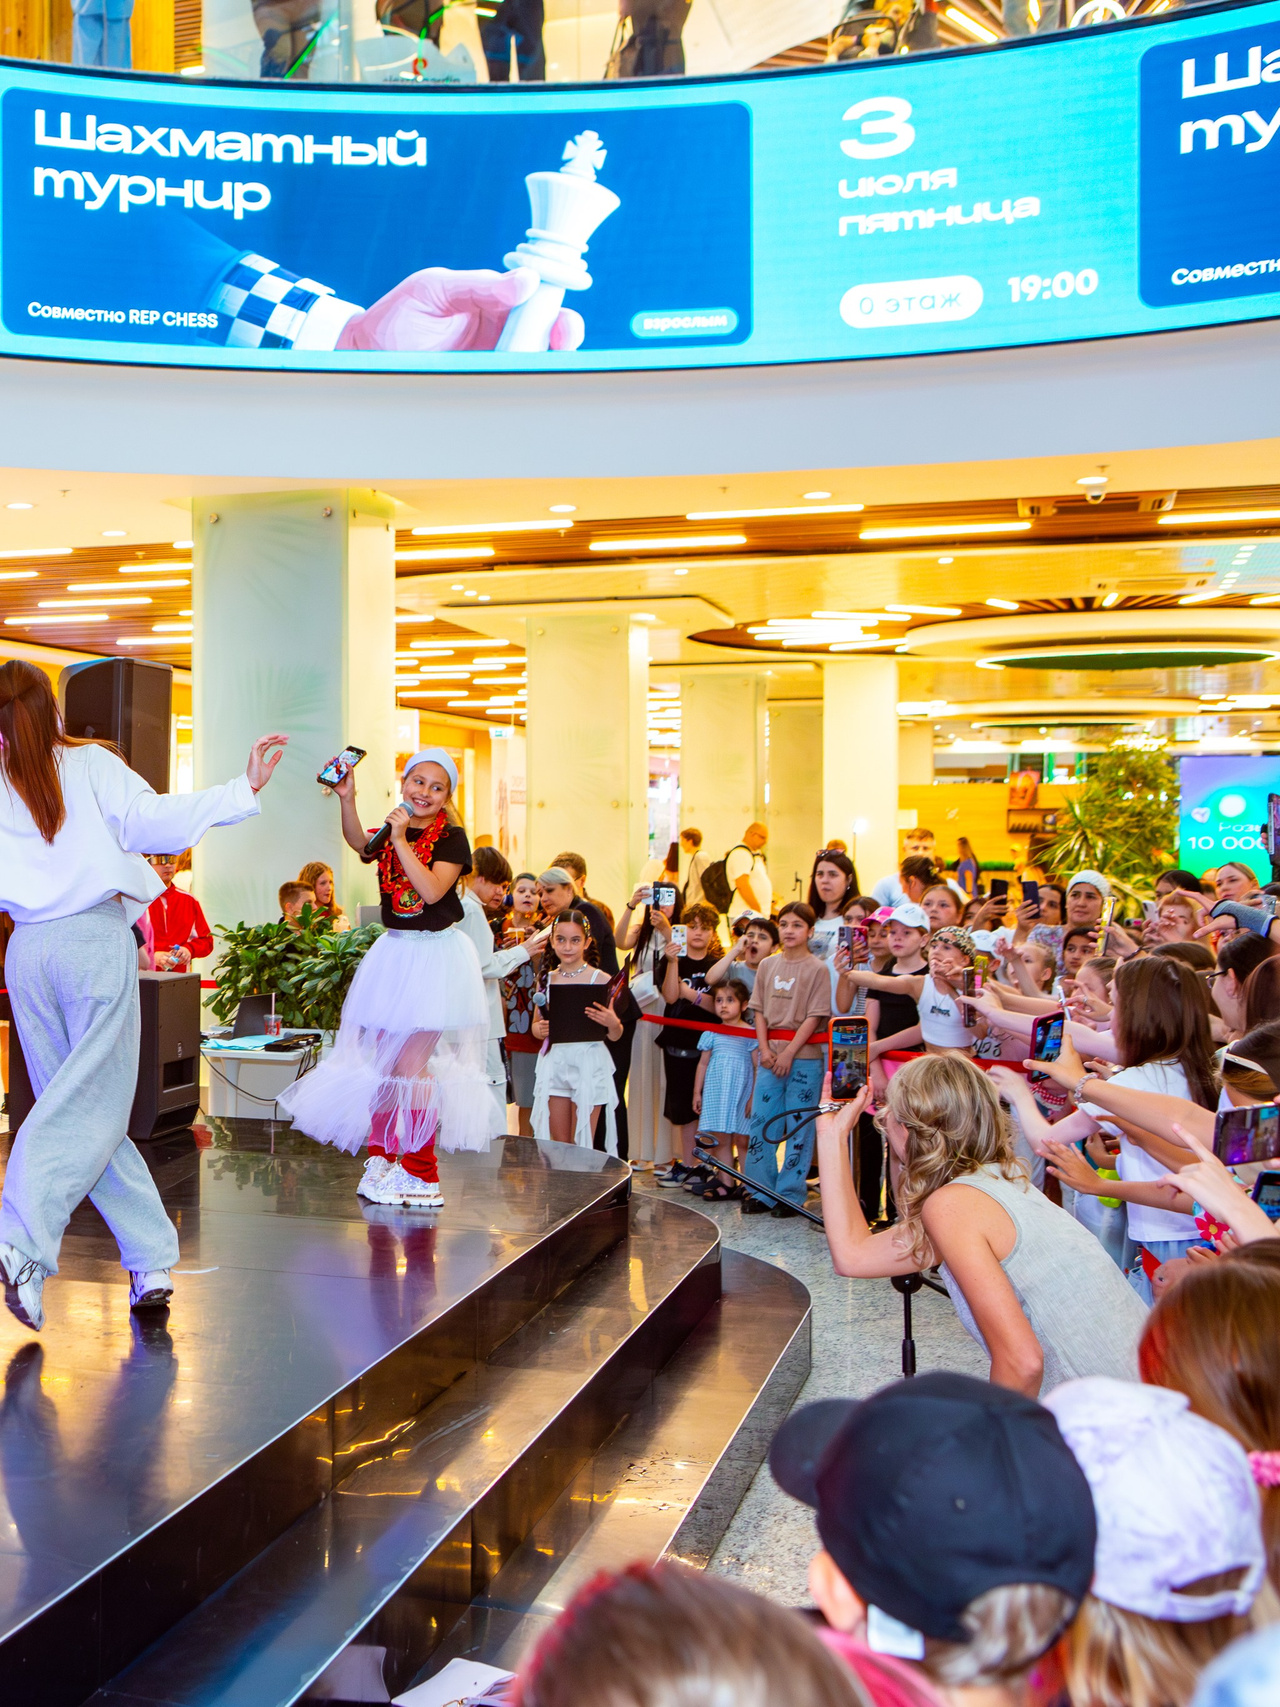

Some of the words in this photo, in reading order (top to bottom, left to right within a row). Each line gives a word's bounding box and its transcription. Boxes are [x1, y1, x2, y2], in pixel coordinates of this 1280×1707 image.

[34, 109, 428, 168] Шахматный
[839, 96, 916, 160] 3
[33, 166, 271, 219] турнир
[838, 167, 958, 199] июля
[838, 196, 1041, 237] пятница
[1007, 268, 1099, 303] 19:00
[27, 301, 126, 325] Совместно
[129, 308, 160, 326] REP
[162, 311, 218, 329] CHESS
[859, 297, 874, 315] 0
[885, 292, 962, 313] этаж
[1187, 835, 1215, 850] 10
